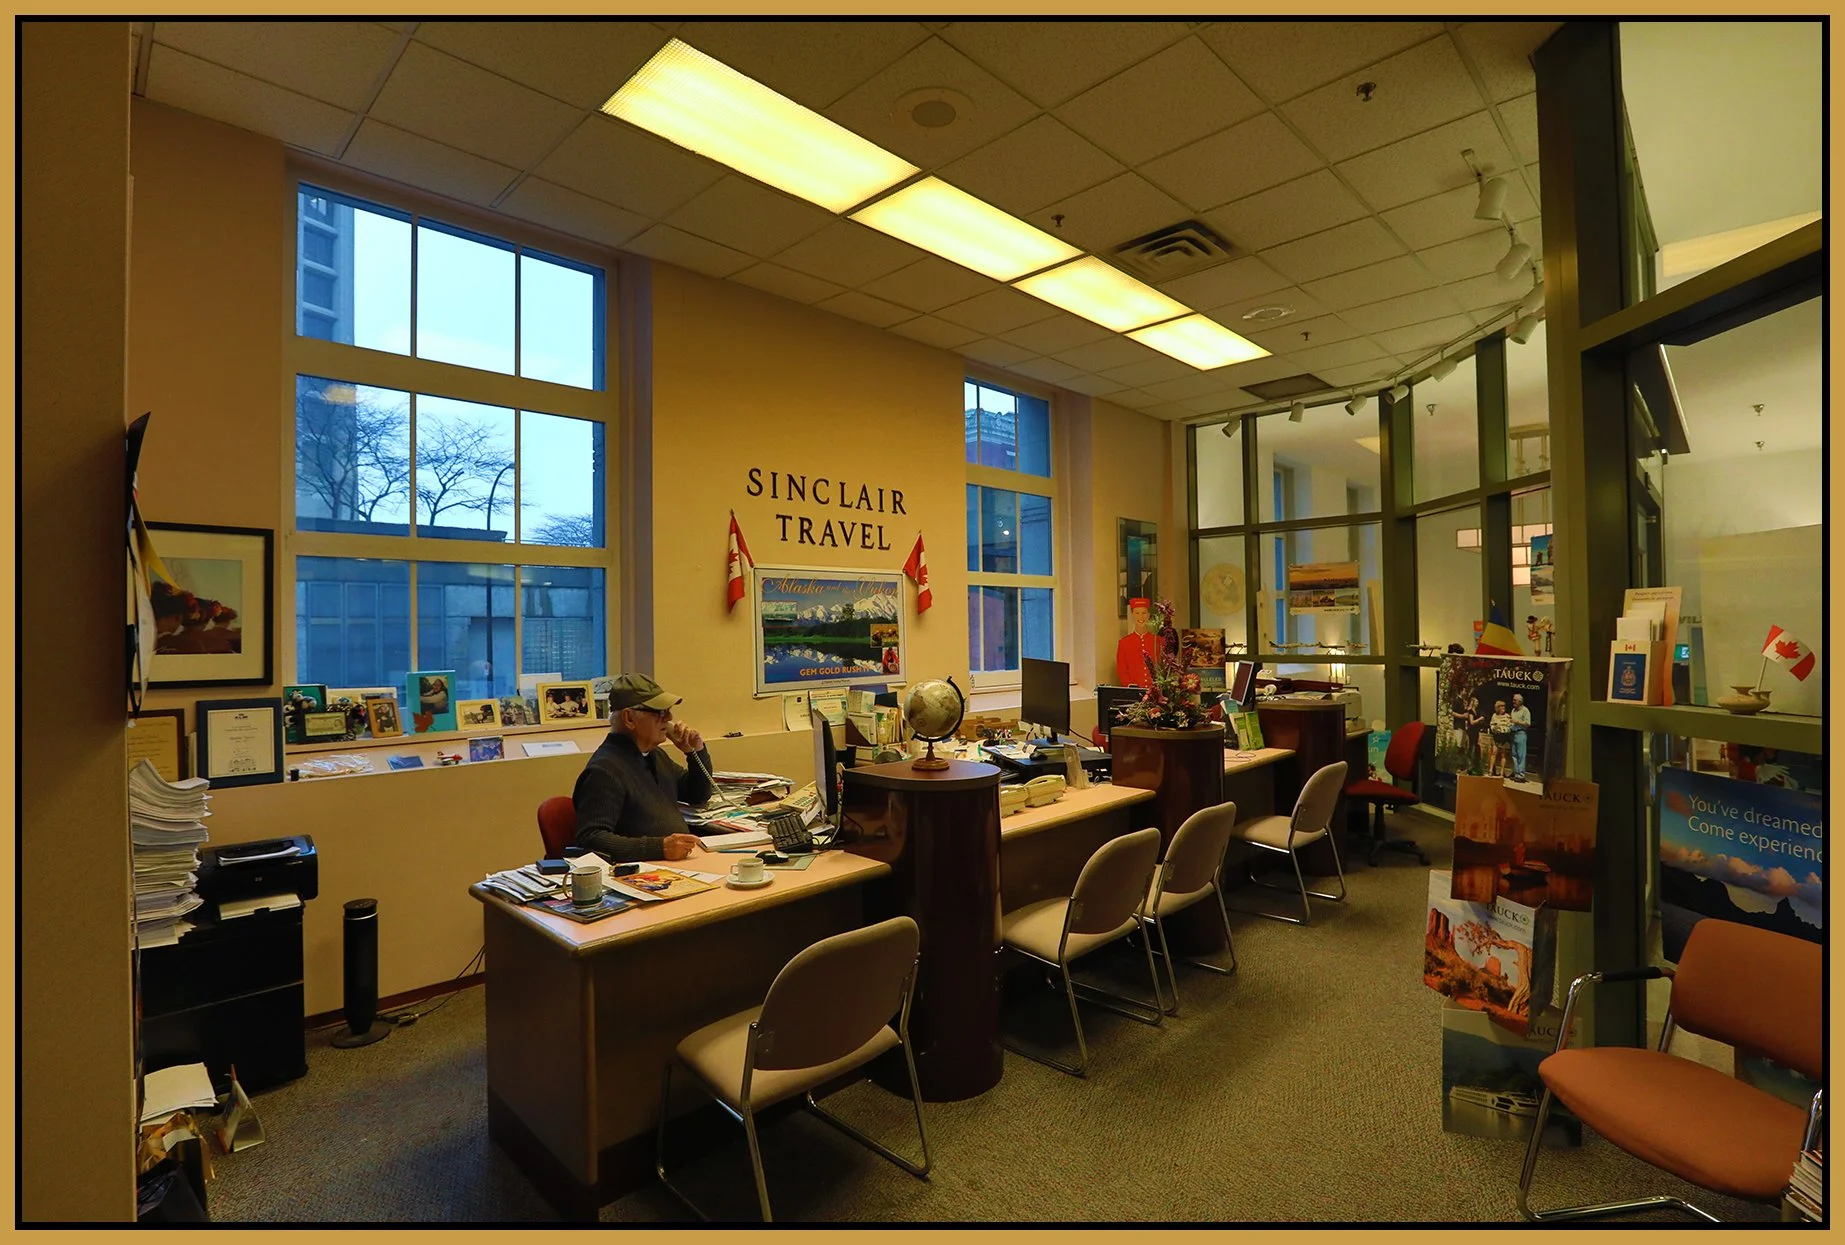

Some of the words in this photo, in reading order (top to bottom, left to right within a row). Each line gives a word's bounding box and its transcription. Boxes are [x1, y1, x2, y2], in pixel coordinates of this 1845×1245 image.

[746, 467, 908, 516] SINCLAIR
[775, 513, 892, 551] TRAVEL
[762, 574, 825, 595] Alaska
[826, 582, 841, 591] and
[799, 667, 817, 677] GEM
[818, 666, 841, 676] GOLD
[841, 665, 862, 674] RUSH
[1494, 668, 1533, 681] TAUCK
[1497, 681, 1541, 690] www.tauck.com
[1688, 793, 1739, 820] You've
[1743, 806, 1823, 839] dreamed
[1687, 815, 1735, 842] Come
